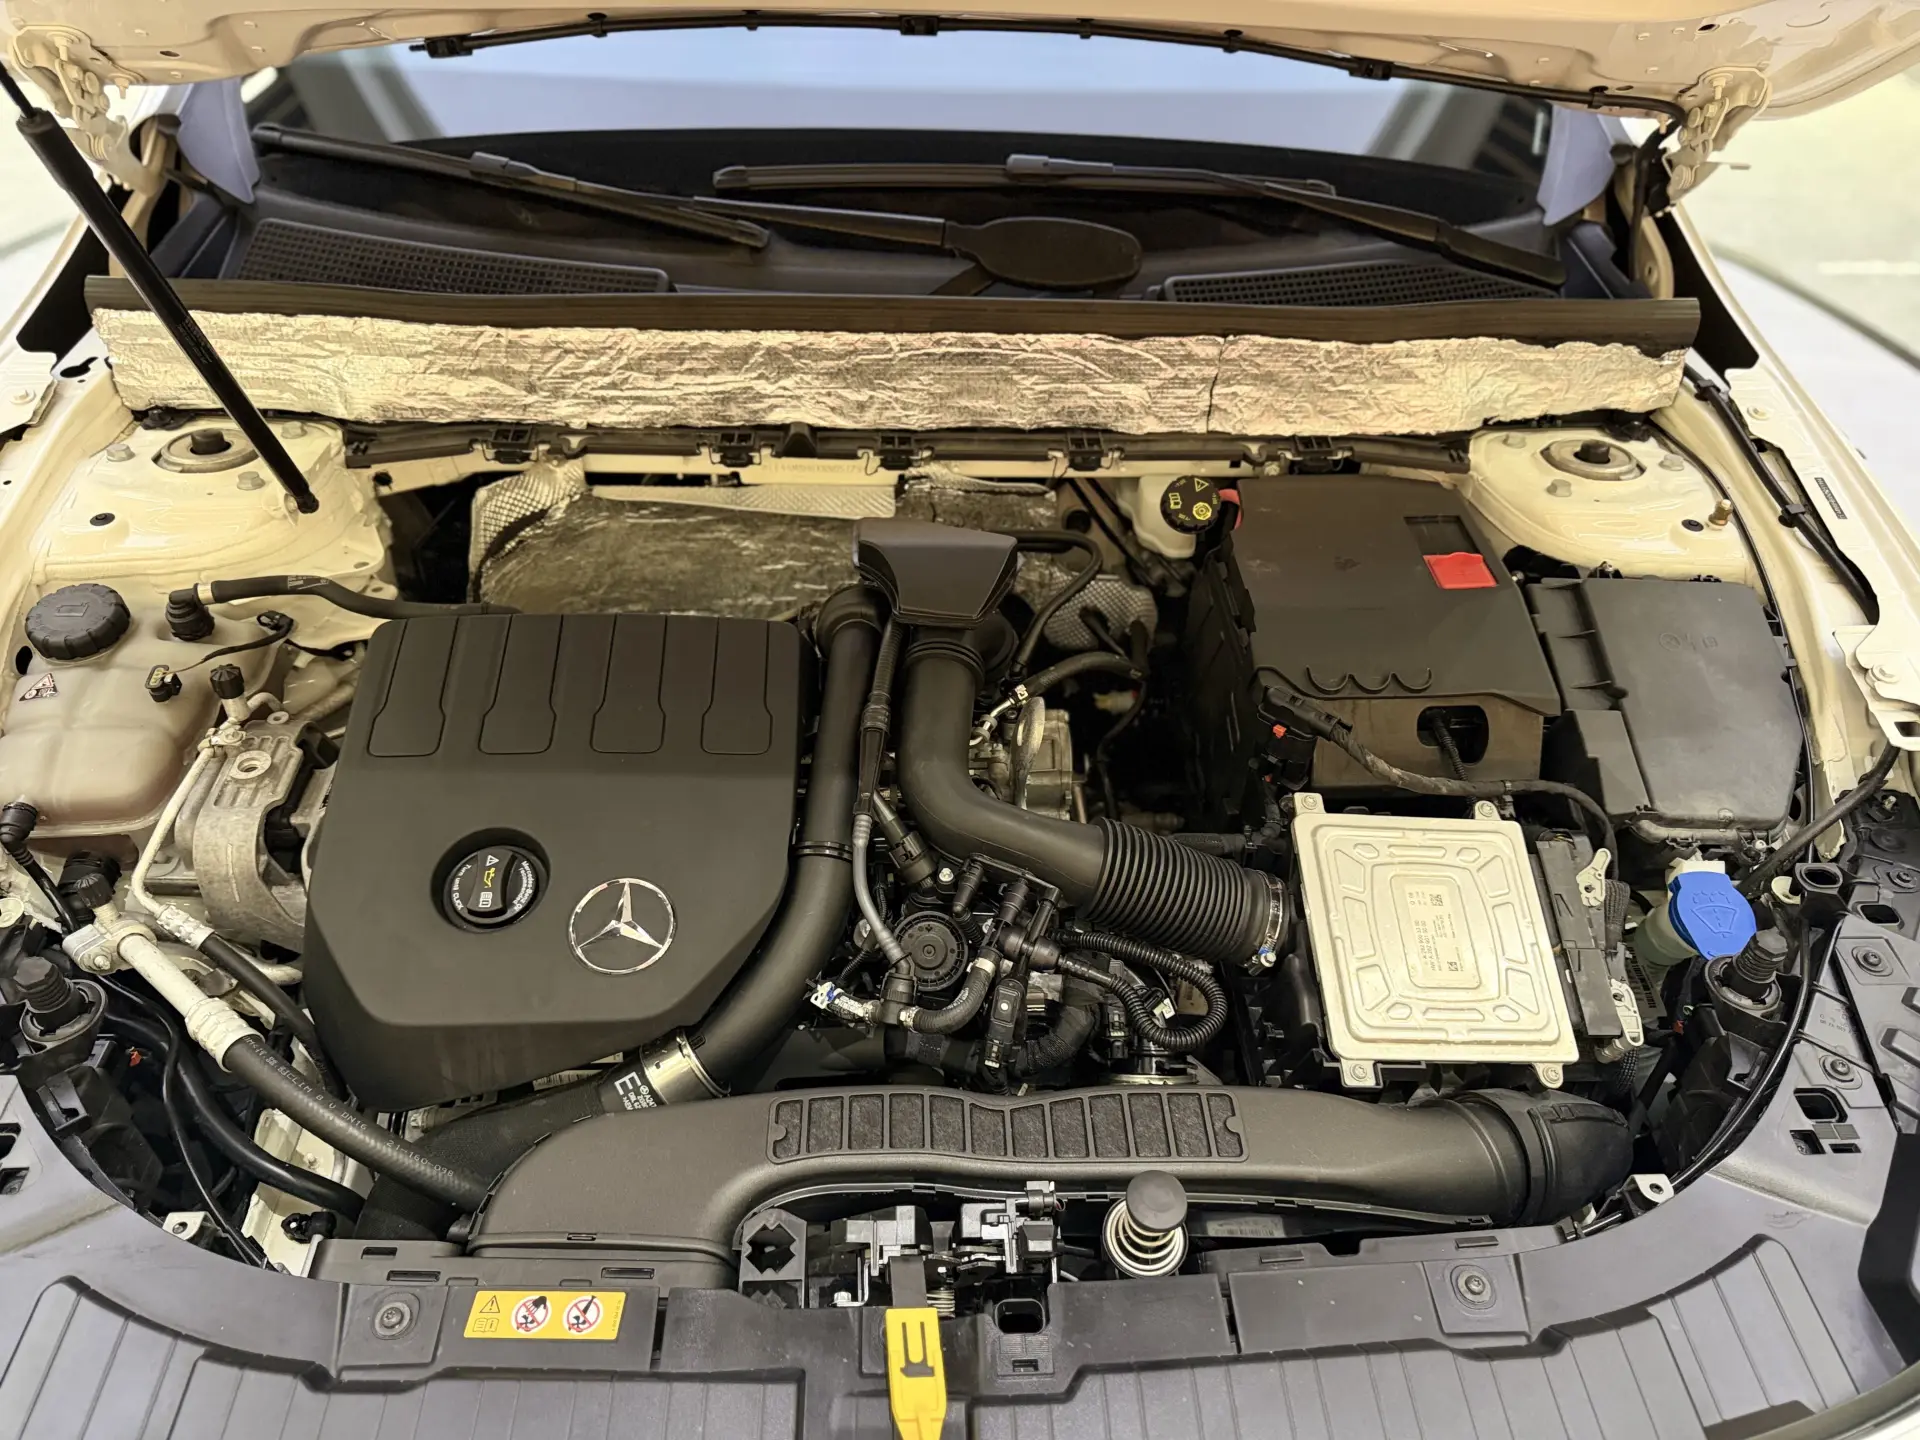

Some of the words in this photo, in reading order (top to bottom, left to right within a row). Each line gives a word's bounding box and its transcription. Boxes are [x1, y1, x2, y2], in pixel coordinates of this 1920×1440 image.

[614, 1072, 641, 1095] E
[340, 1111, 368, 1130] DN16
[386, 1139, 454, 1177] 21-160-098
